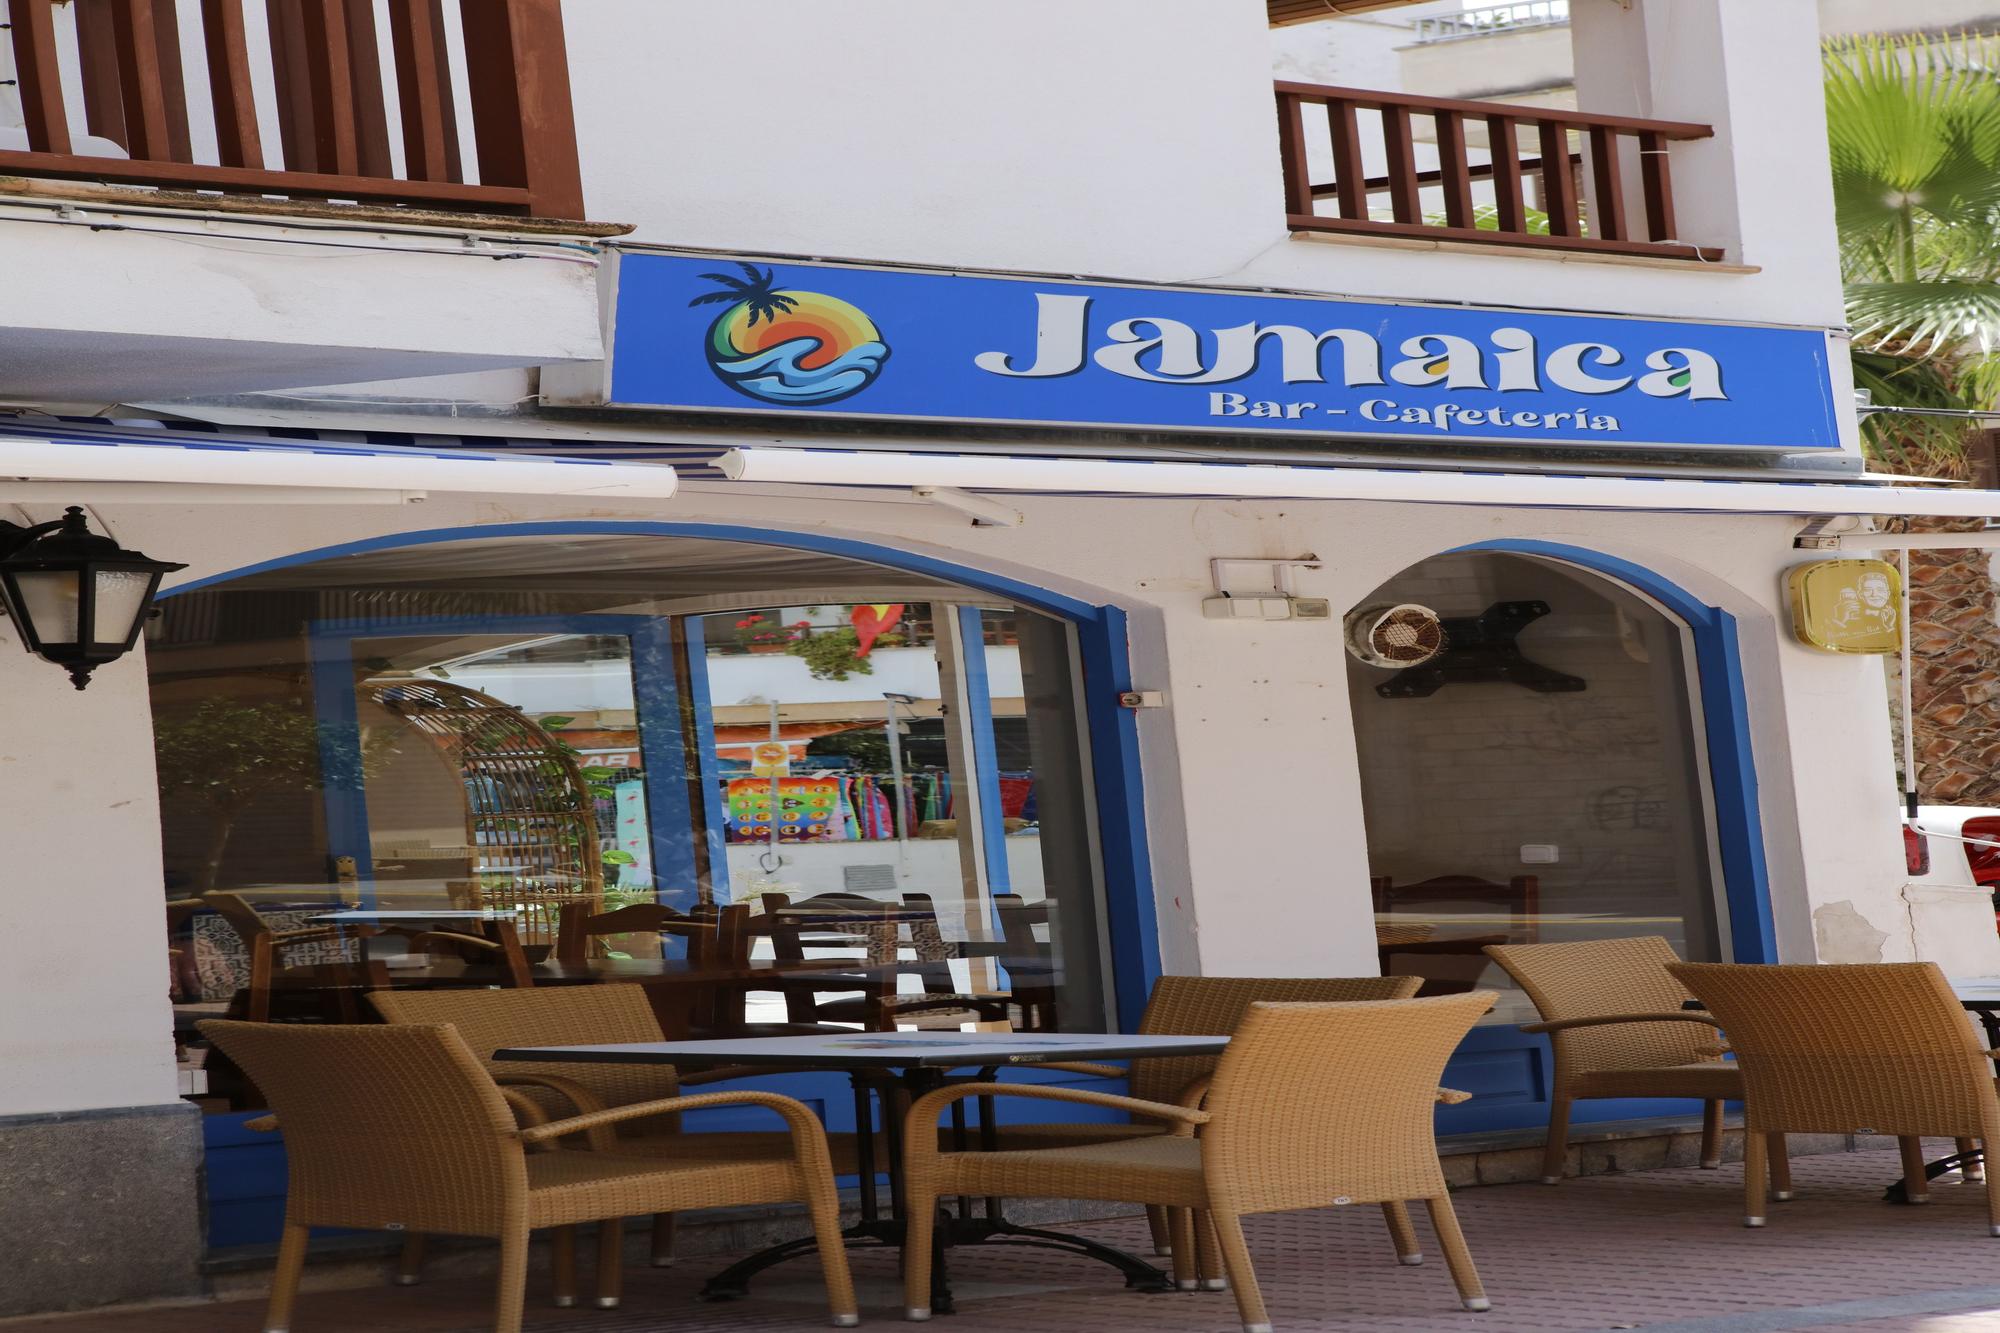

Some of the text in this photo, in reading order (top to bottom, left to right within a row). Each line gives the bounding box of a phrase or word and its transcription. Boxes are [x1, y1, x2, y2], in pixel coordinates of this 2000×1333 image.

[974, 292, 1728, 401] Jamaica
[1208, 391, 1317, 420] Bar
[1358, 399, 1620, 433] Cafetería
